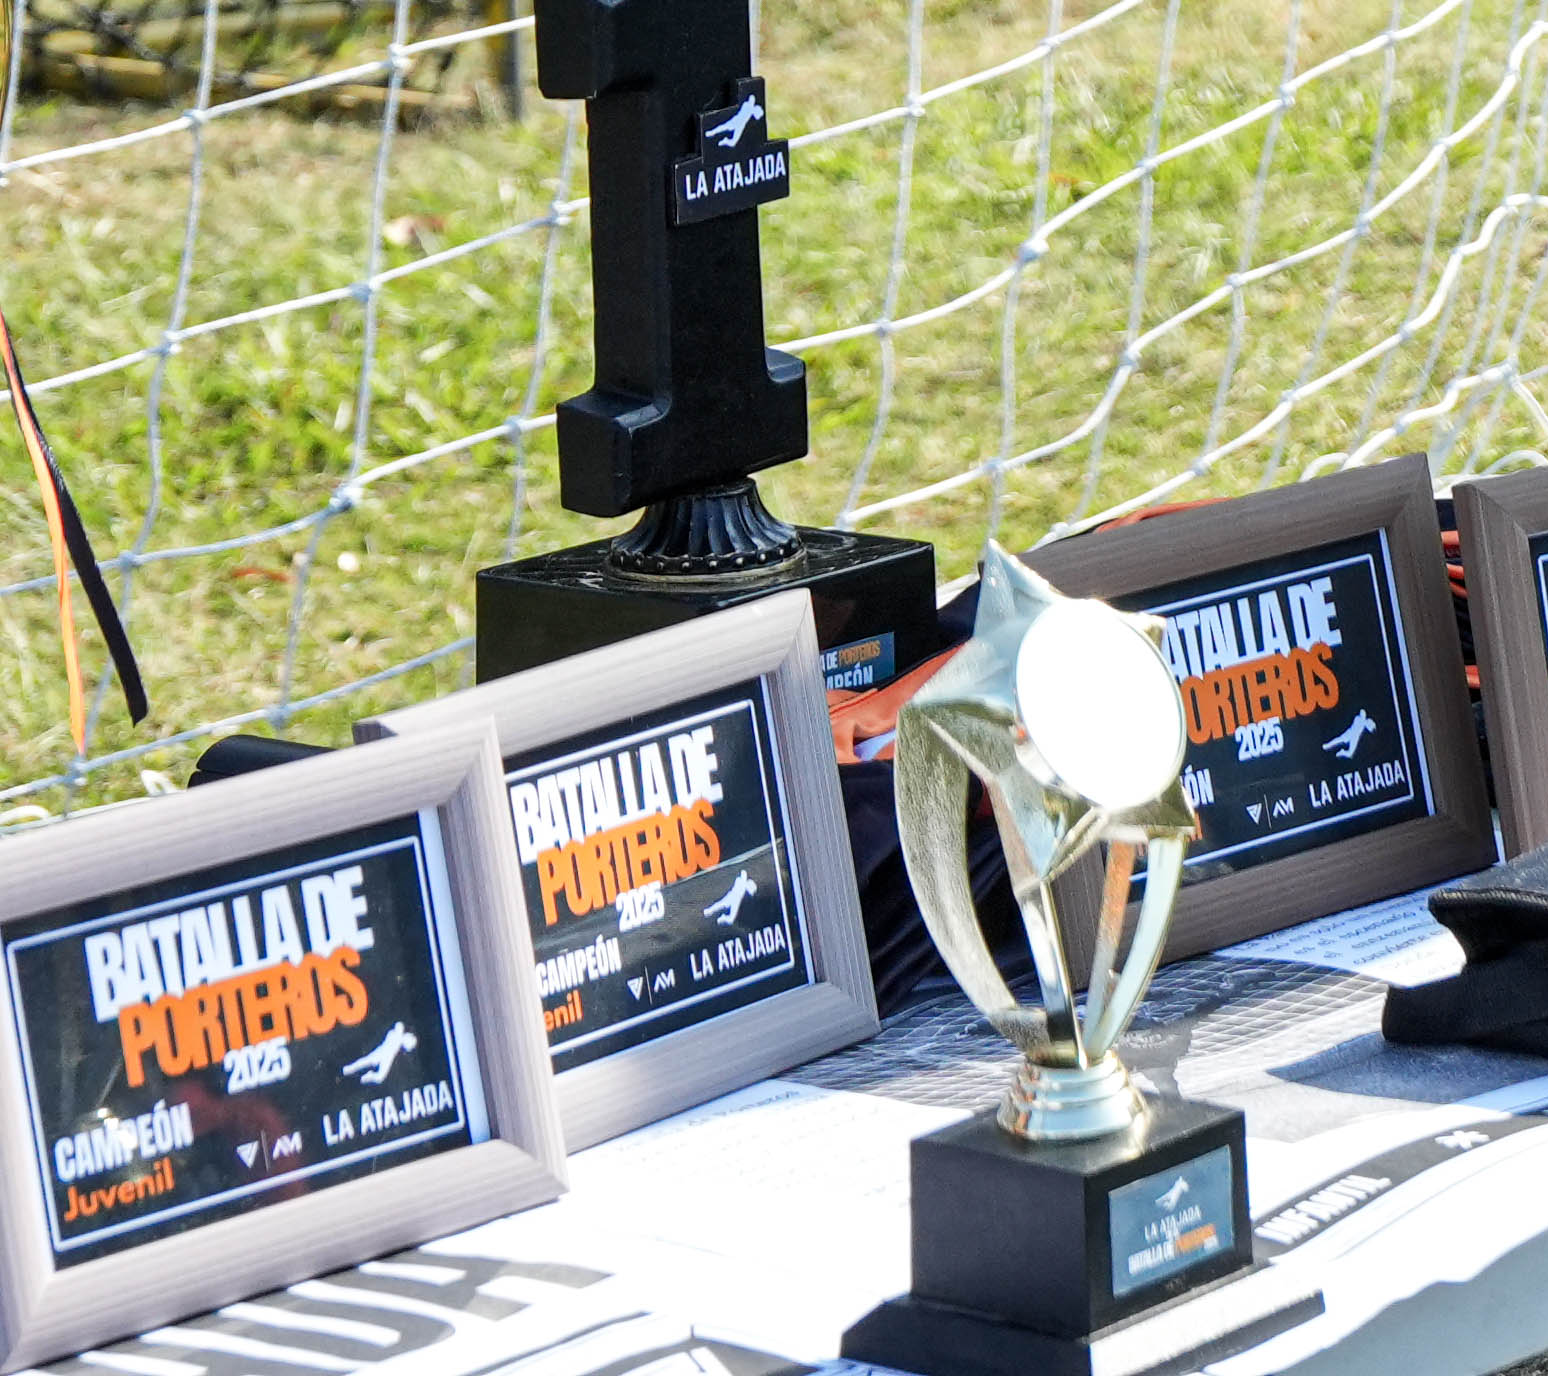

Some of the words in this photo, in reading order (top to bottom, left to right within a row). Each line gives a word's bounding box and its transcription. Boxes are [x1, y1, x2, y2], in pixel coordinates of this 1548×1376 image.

[685, 171, 708, 201] LA
[713, 151, 786, 194] ATAJADA
[1162, 591, 1292, 681] ATALLA
[1289, 576, 1342, 656] DE
[1181, 640, 1340, 745] ORTEROS
[1235, 717, 1284, 762] 2025
[510, 742, 672, 864] BATALLA
[668, 726, 724, 811] DE
[1309, 780, 1332, 807] LA
[1337, 758, 1406, 804] ATAJADA
[536, 797, 720, 927] PORTEROS
[616, 881, 665, 932] 2025
[84, 885, 304, 1023] BATALLA
[301, 864, 375, 957] DE
[690, 953, 714, 980] LA
[718, 923, 786, 971] ATAJADA
[117, 944, 369, 1087] PORTEROS
[544, 993, 584, 1032] enil
[224, 1036, 292, 1094] 2025
[54, 1099, 195, 1182] CAMPEÓN
[323, 1112, 355, 1146] LA
[360, 1081, 454, 1135] ATAJADA
[63, 1158, 175, 1222] Juvenil
[1254, 1174, 1392, 1245] INFANTIL
